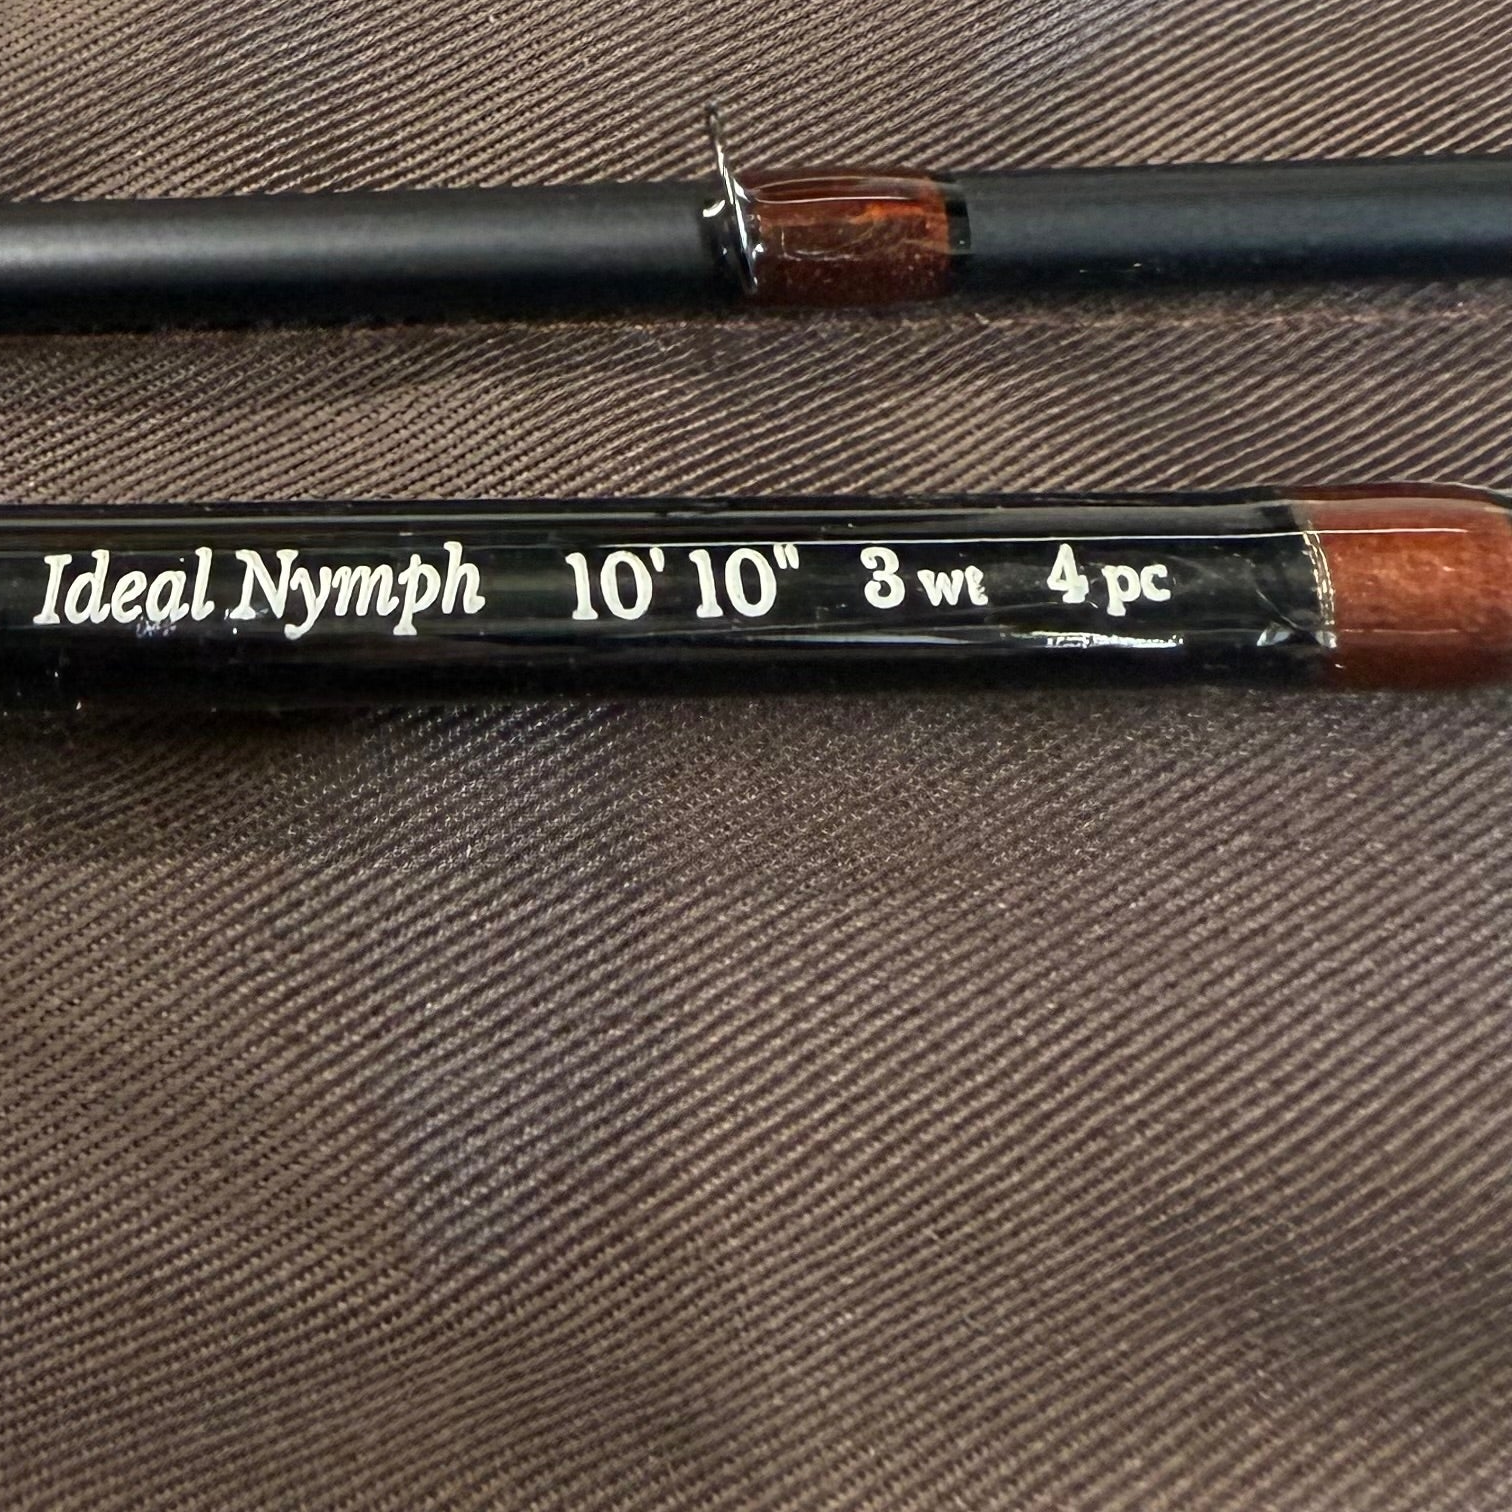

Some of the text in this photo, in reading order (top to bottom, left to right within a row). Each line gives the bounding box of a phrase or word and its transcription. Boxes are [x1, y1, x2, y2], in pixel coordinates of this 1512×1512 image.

[33, 541, 1173, 640] Ideal Nymph 10' 10" 3 wt 4 pc
